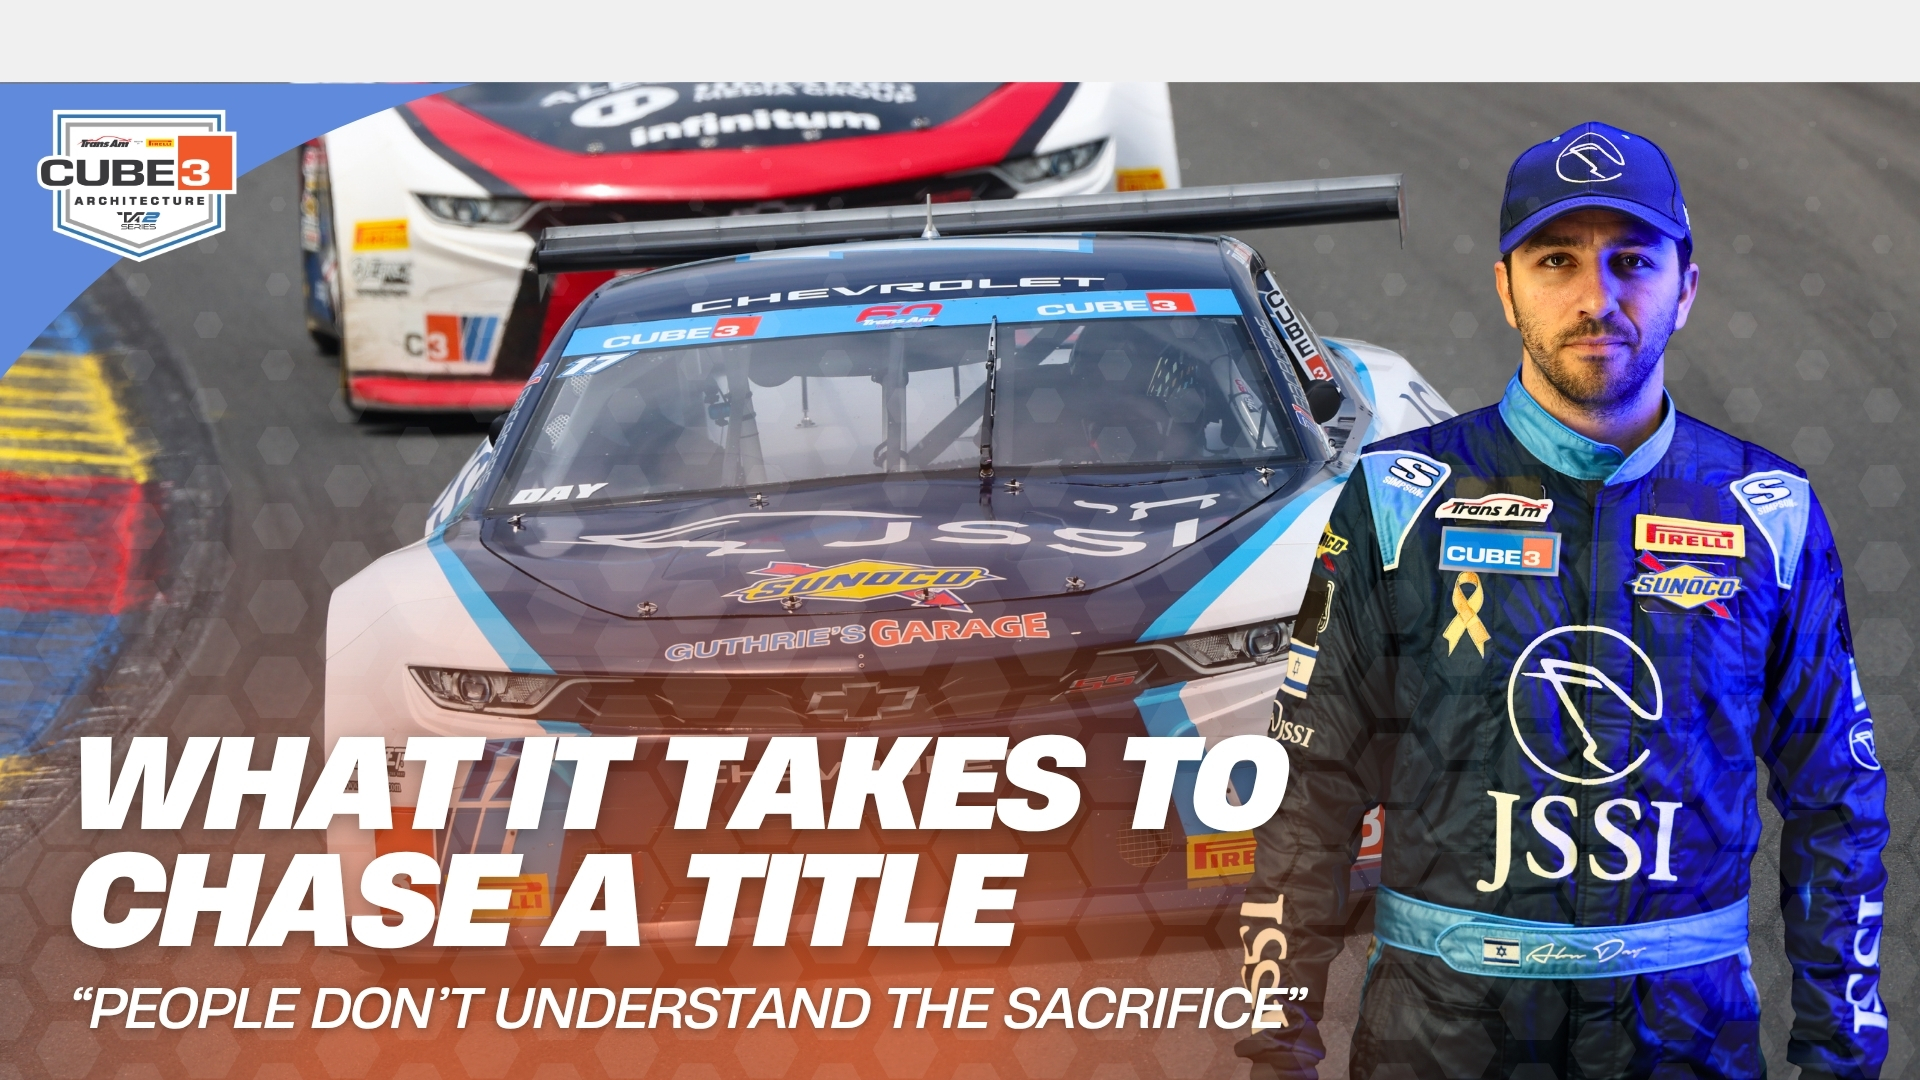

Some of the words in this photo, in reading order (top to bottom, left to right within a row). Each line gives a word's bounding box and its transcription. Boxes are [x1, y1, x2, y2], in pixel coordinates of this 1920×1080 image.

[630, 109, 881, 147] infinitum
[691, 276, 1105, 313] CHEVROLET
[557, 351, 638, 378] 17
[508, 482, 609, 505] DAY
[1383, 475, 1422, 498] SIMPSON
[1451, 501, 1503, 516] Trans
[1504, 505, 1542, 518] Am
[1757, 498, 1797, 516] SIMPSON
[823, 517, 1199, 558] JSSI
[1646, 522, 1735, 549] PIRELLI
[755, 570, 977, 598] SUNOCO
[1637, 577, 1736, 596] SUNOCO
[868, 611, 1051, 649] GARAGE
[1277, 719, 1315, 748] JSSI
[1194, 837, 1257, 870] PIRE
[1476, 789, 1683, 893] JSSI
